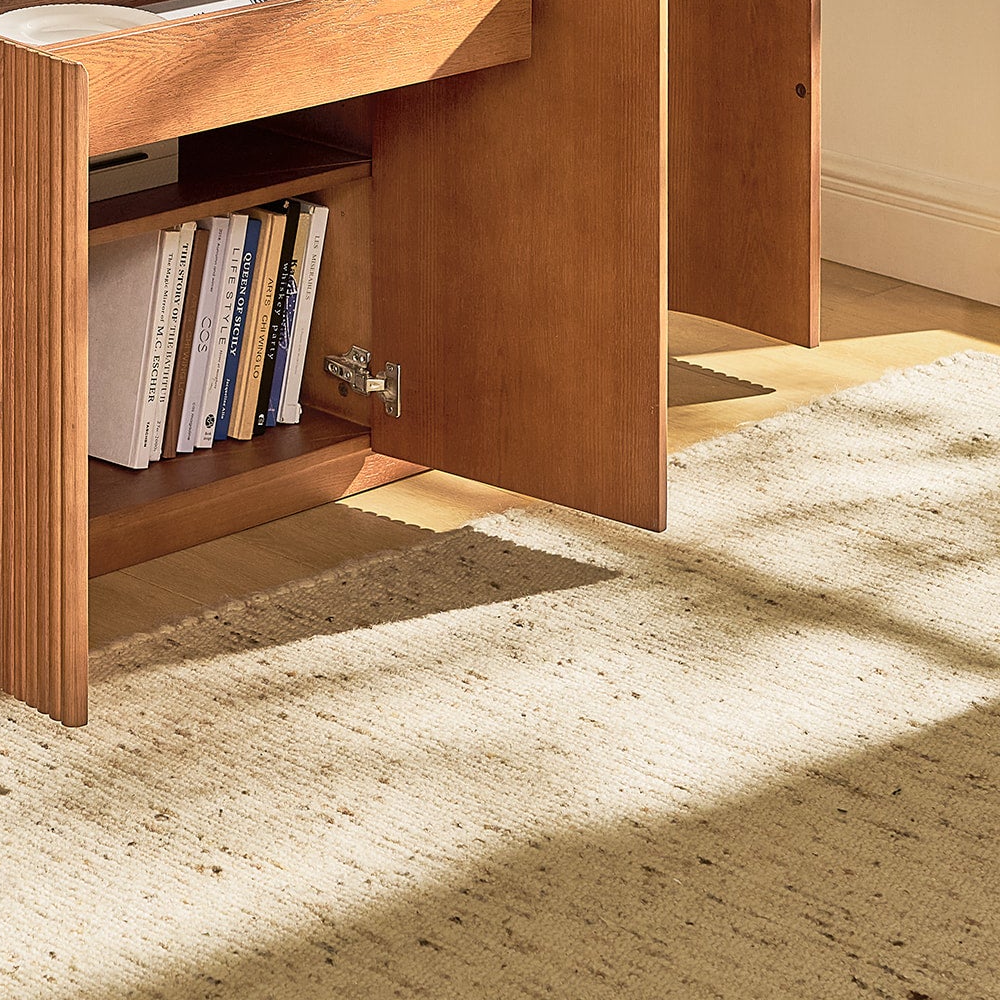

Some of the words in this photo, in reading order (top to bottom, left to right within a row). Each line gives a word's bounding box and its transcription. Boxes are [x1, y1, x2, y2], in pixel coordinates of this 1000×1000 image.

[167, 252, 175, 266] The
[180, 242, 188, 267] THE
[163, 267, 173, 288] Magic
[173, 269, 184, 305] STORY
[239, 252, 252, 294] QUEEN
[161, 291, 169, 313] Mirror
[264, 277, 273, 306] ARTS
[275, 262, 289, 315] whiskey
[160, 313, 165, 322] of
[172, 308, 178, 322] OF
[236, 297, 244, 314] OF
[167, 324, 176, 348] THE
[197, 315, 212, 353] COS
[230, 315, 241, 356] SICILY
[256, 334, 264, 362] WING
[267, 324, 279, 360] party
[147, 355, 161, 403] ESCHER
[158, 351, 172, 403] BATHTUB
[253, 365, 260, 379] LO
